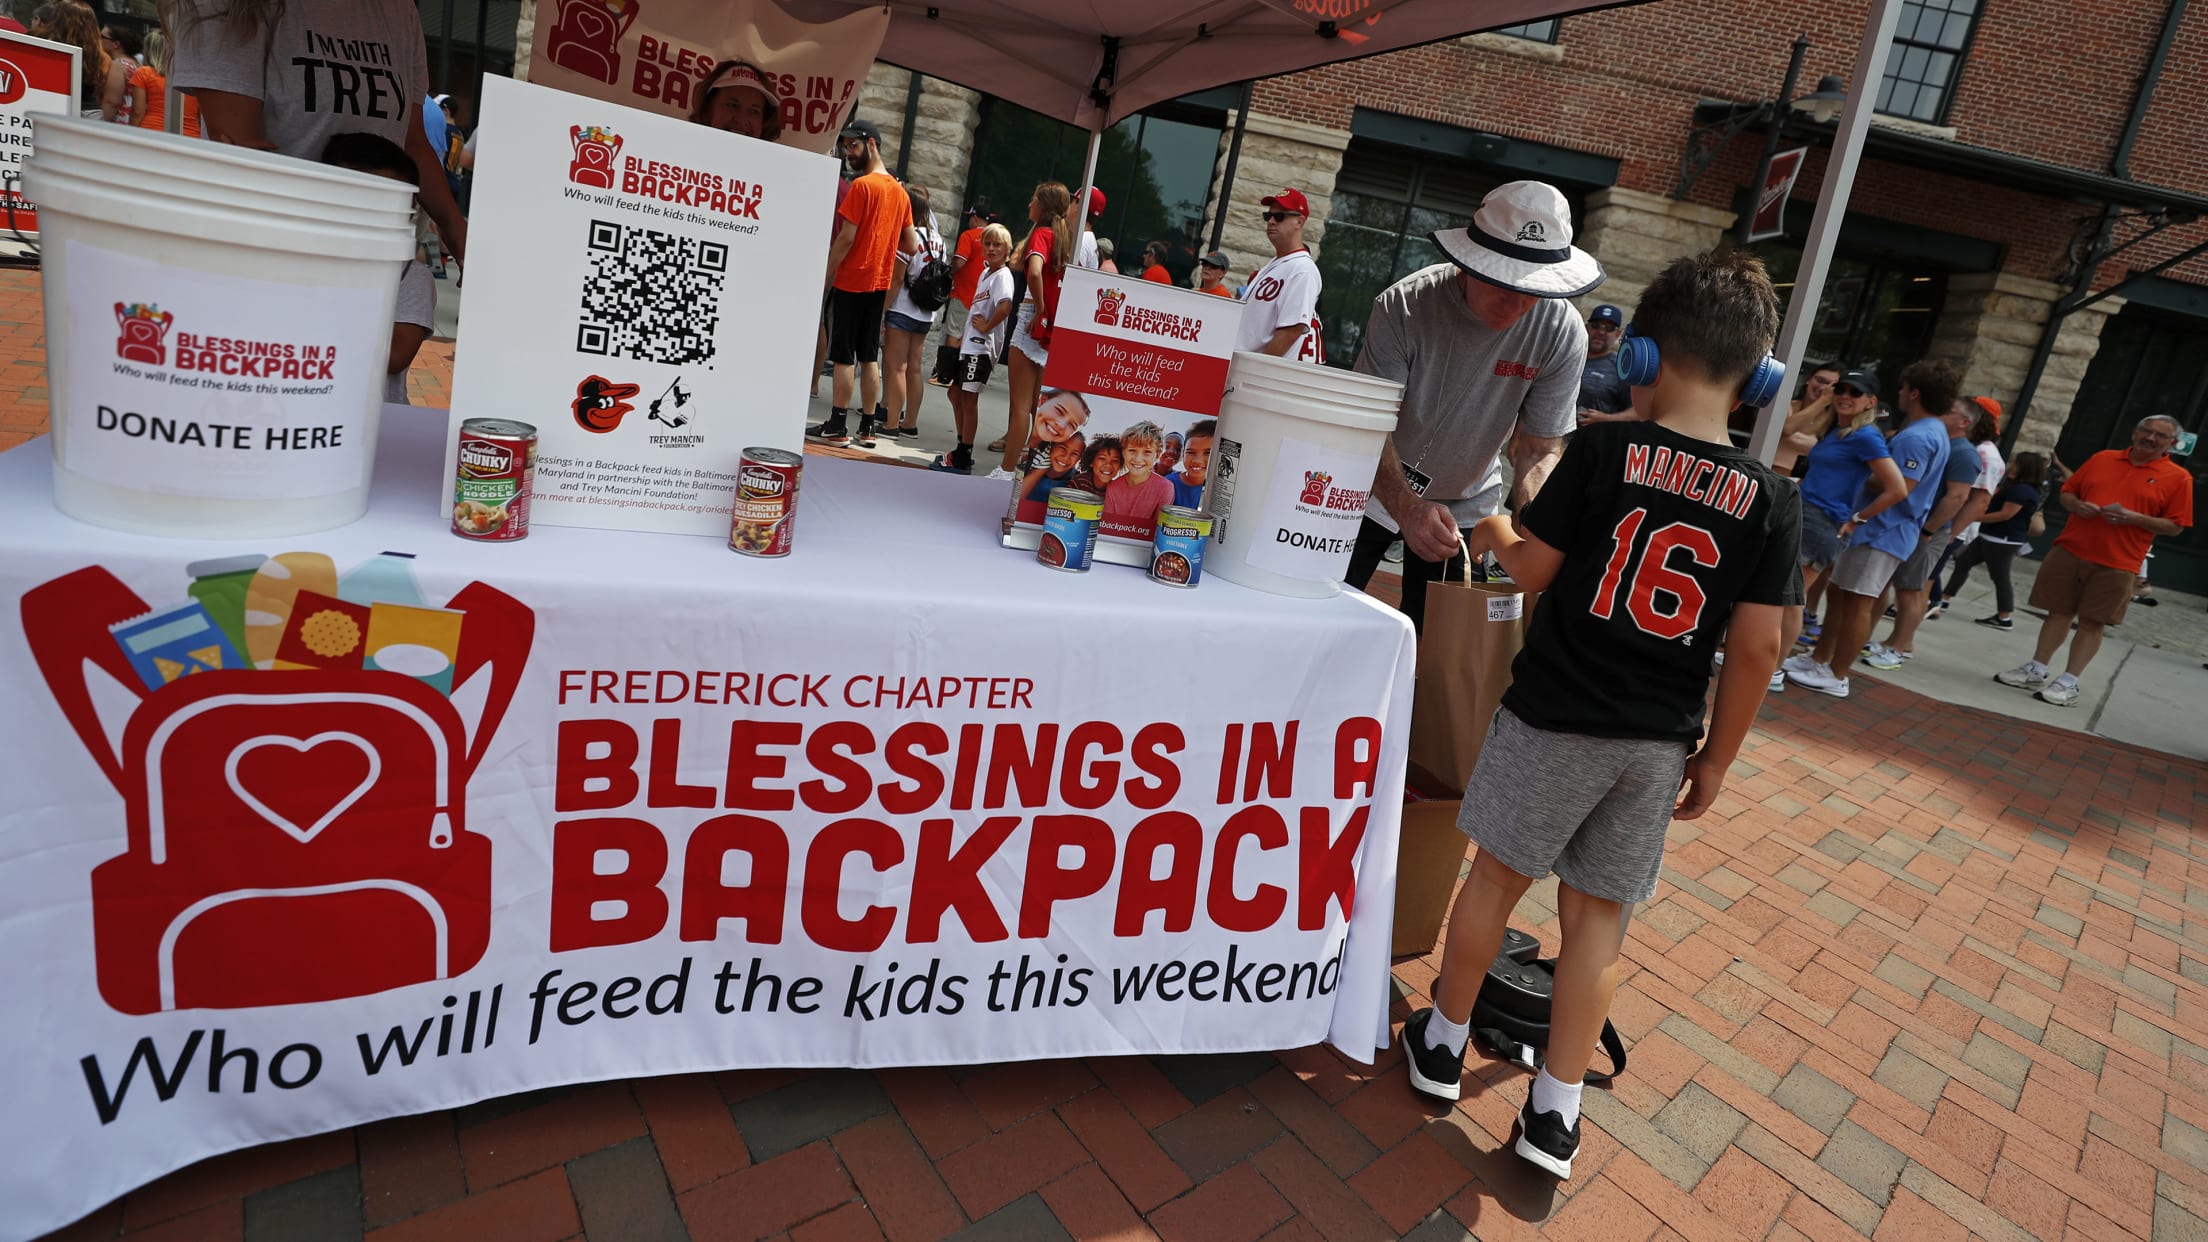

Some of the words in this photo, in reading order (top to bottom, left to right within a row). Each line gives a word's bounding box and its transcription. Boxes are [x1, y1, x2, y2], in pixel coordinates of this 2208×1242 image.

[336, 38, 392, 67] WITH
[637, 34, 797, 97] BLESGS
[805, 75, 834, 101] IN
[839, 79, 855, 102] A
[291, 56, 406, 122] TREY
[631, 58, 847, 135] BAACK
[624, 155, 723, 190] BLESSINGS
[728, 178, 747, 196] IN
[751, 184, 763, 199] A
[621, 171, 762, 221] BACKPACK
[564, 187, 592, 202] Who
[594, 195, 614, 207] will
[616, 198, 640, 212] feed
[642, 203, 661, 216] the
[662, 207, 685, 221] kids
[687, 212, 706, 225] this
[708, 218, 759, 236] weekend?
[1121, 314, 1201, 342] BACKPACK
[1124, 305, 1180, 324] BLESSINGS
[1181, 317, 1193, 328] IN
[1194, 319, 1202, 330] A
[176, 332, 295, 359] BLESSINGS
[301, 345, 320, 360] IN
[326, 345, 337, 360] A
[1095, 342, 1127, 361] Who
[1130, 352, 1154, 366] will
[1153, 354, 1185, 376] feed
[175, 348, 336, 380] BACKPACK
[1110, 361, 1133, 378] the
[1135, 366, 1161, 383] kids
[112, 362, 143, 379] Who
[145, 370, 167, 383] will
[169, 373, 199, 388] feed
[202, 379, 223, 391] the
[226, 381, 252, 393] kids
[255, 383, 278, 394] this
[281, 384, 334, 396] weekend?
[1087, 373, 1112, 389] this
[1115, 380, 1180, 401] weekend?
[96, 404, 252, 450] DONATE
[264, 425, 344, 451] HERE
[649, 435, 669, 444] TREY
[670, 435, 704, 444] MANCINI
[460, 448, 508, 470] CHUNKY
[535, 454, 573, 468] lessings
[575, 457, 584, 467] in
[595, 460, 640, 473] Backpack
[641, 463, 662, 475] feed
[664, 466, 682, 477] kids
[683, 468, 693, 478] in
[694, 469, 736, 482] Baltimore
[462, 483, 514, 493] CHICKEN
[537, 466, 584, 480] Maryland
[586, 471, 596, 480] in
[597, 472, 651, 486] partnership
[653, 476, 673, 488] with
[675, 479, 690, 489] the
[691, 480, 734, 493] Baltimore
[560, 481, 579, 491] and
[581, 482, 602, 494] Trey
[604, 485, 642, 496] Mancini
[643, 488, 698, 501] Foundation!
[740, 472, 781, 493] CHUNKY
[1623, 442, 1759, 521] MANCINI
[462, 490, 514, 498] NOODLE
[549, 494, 574, 503] more
[576, 495, 587, 504] at
[747, 503, 783, 512] CHICKEN
[1295, 504, 1310, 514] Who
[1098, 520, 1150, 536] backpack.org
[1163, 526, 1197, 537] PROGRESSO
[1276, 527, 1343, 554] DONATE
[1343, 538, 1356, 553] HE
[1588, 506, 1722, 641] 16
[1489, 610, 1504, 619] 467
[557, 669, 829, 709] FREDERICK
[843, 674, 1034, 711] CHAPTER
[553, 717, 1187, 815] BLESSINGS
[1216, 719, 1300, 805] IN
[1333, 716, 1383, 800] A
[549, 804, 1371, 954] BACKPACK
[79, 1028, 324, 1127] Who
[355, 982, 504, 1077] will
[527, 956, 693, 1046] feed
[712, 957, 823, 1016] the
[843, 957, 970, 1023] kids
[986, 953, 1094, 1013] this
[1111, 943, 1346, 1005] weekend
